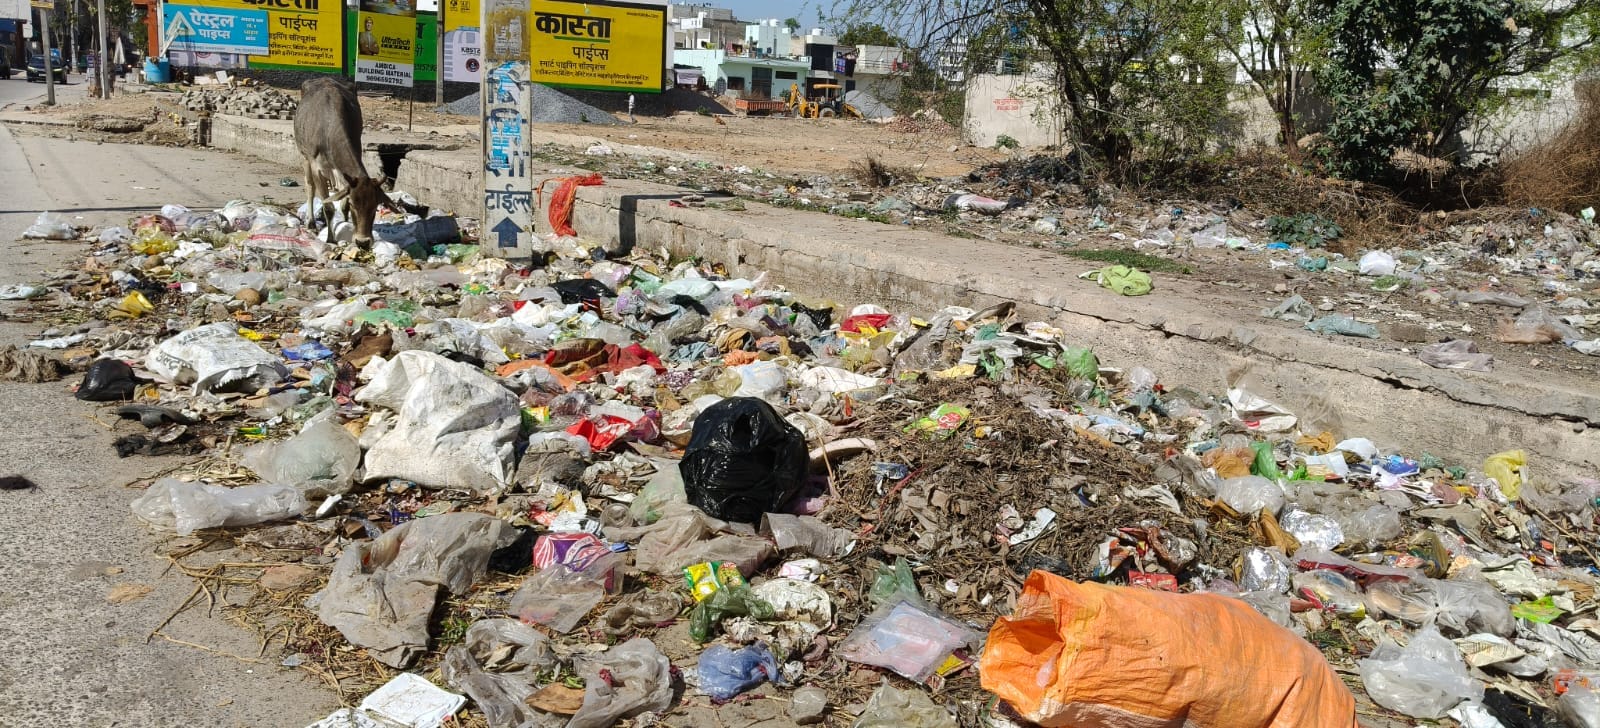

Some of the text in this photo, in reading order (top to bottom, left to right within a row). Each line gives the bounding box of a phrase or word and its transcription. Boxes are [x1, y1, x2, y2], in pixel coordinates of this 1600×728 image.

[189, 9, 235, 29] ऐस्ट्रल
[279, 15, 318, 32] पाईप्स
[534, 11, 611, 38] कास्ता
[572, 43, 609, 61] पाईप्स
[358, 67, 411, 78] BUILDING MATERIAL
